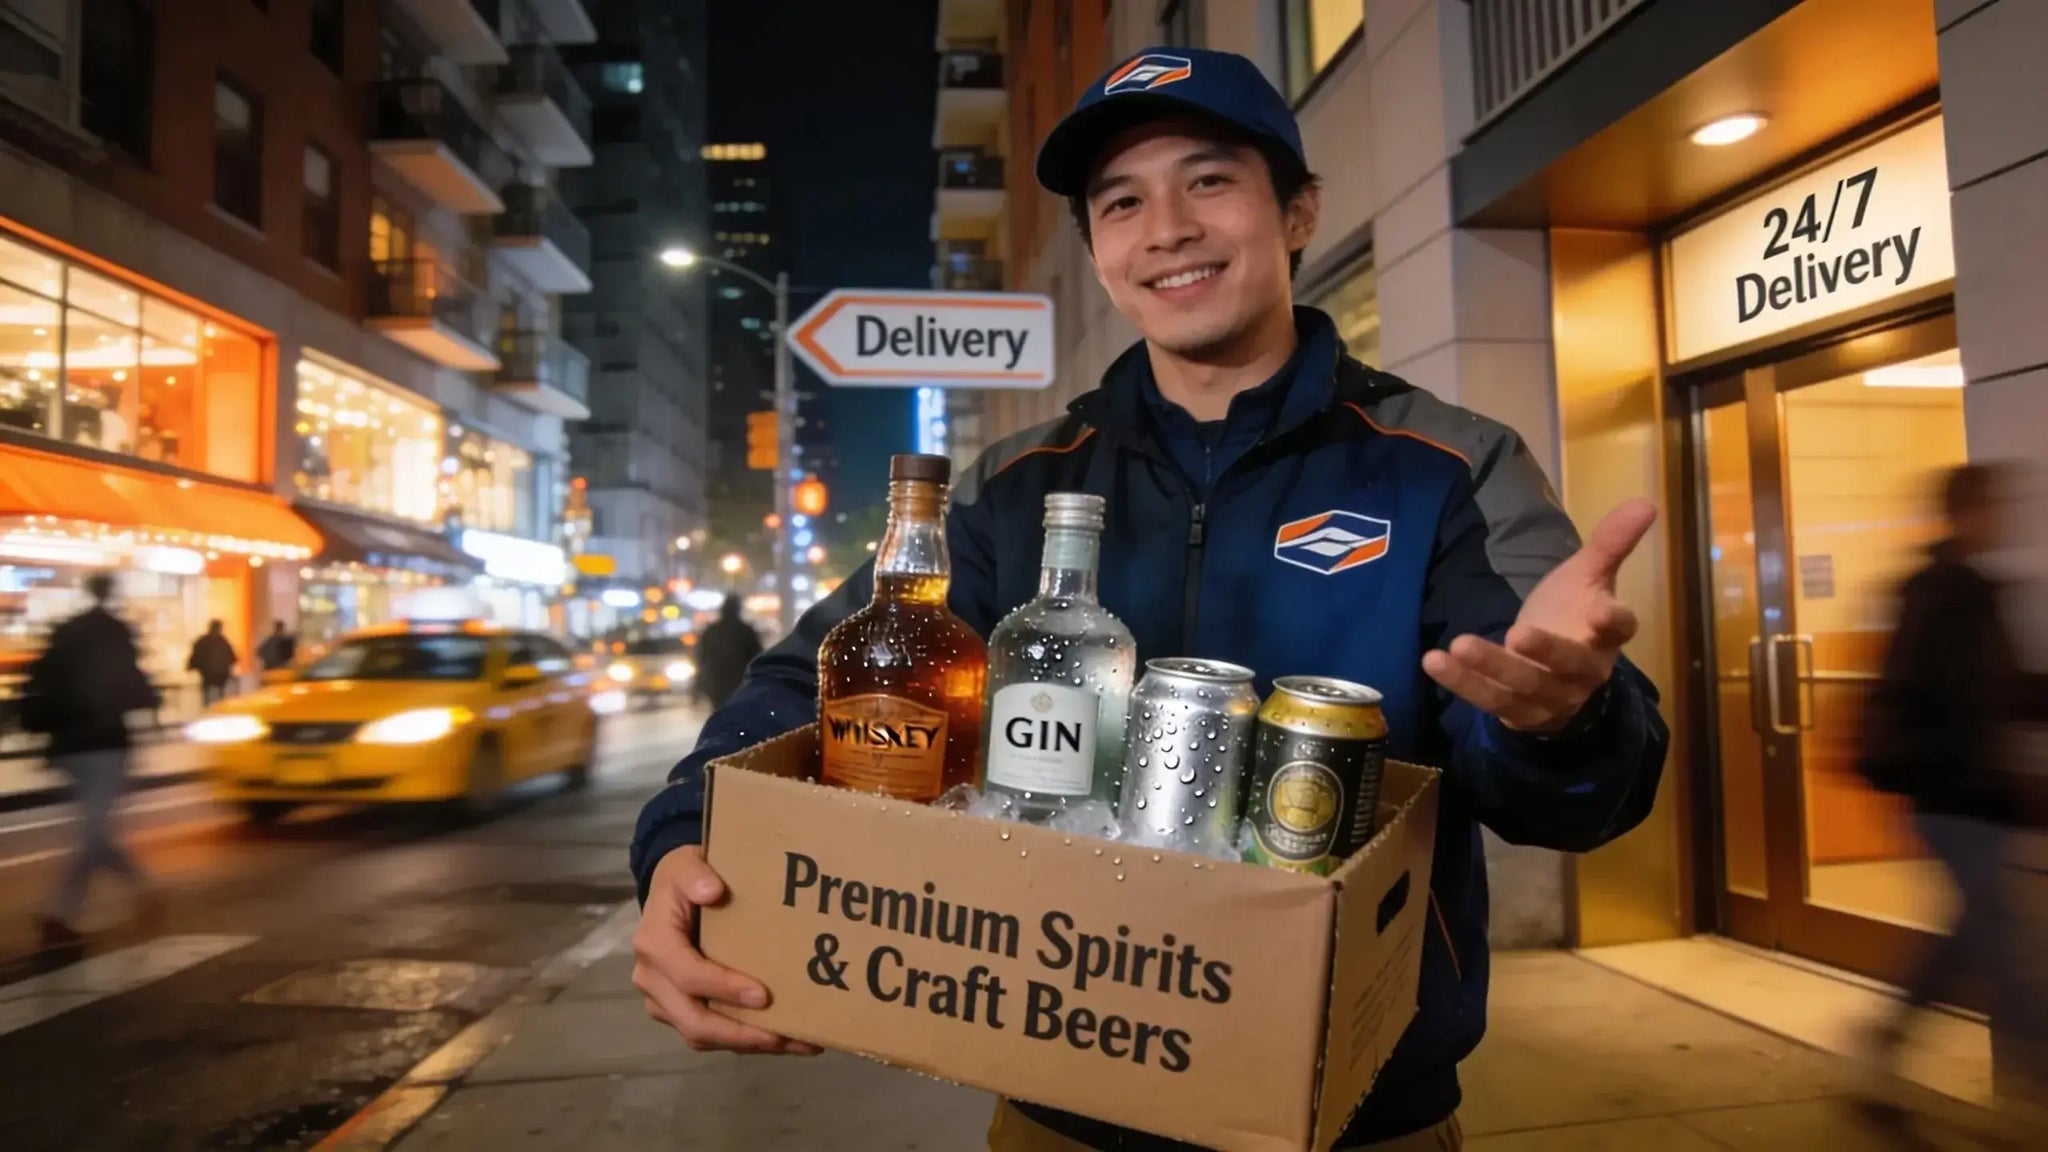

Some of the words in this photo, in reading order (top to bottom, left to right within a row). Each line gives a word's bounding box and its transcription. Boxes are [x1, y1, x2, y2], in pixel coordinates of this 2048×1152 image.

[1763, 166, 1878, 260] 24/7
[1735, 226, 1922, 323] Delivery
[856, 314, 1029, 370] Delivery
[1005, 716, 1082, 752] GIN
[782, 851, 1020, 959] Premium
[1036, 910, 1233, 1004] Spirits
[807, 933, 850, 991] &
[866, 945, 1007, 1030] Craft
[1023, 980, 1192, 1073] Beers
